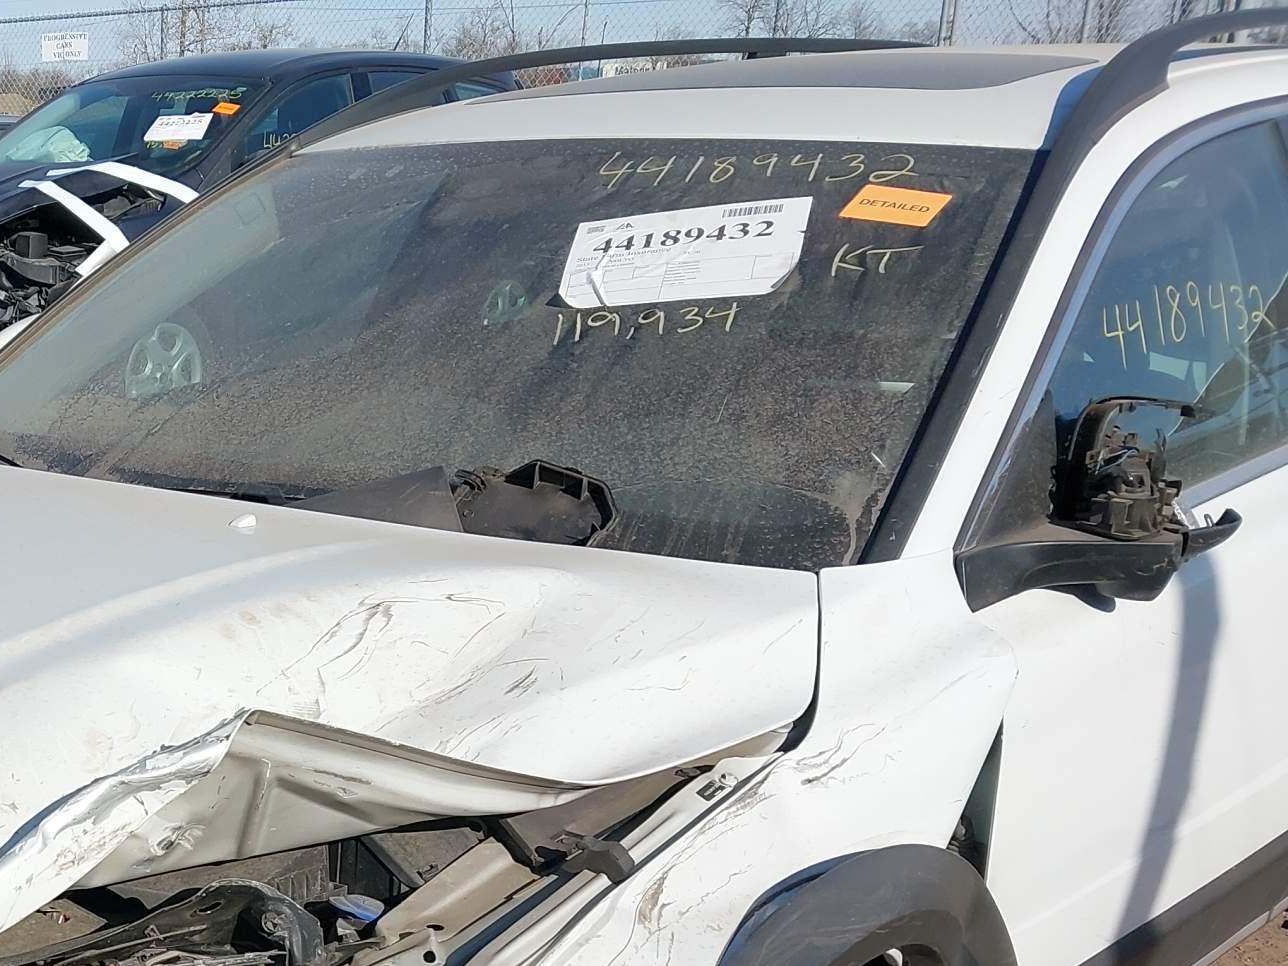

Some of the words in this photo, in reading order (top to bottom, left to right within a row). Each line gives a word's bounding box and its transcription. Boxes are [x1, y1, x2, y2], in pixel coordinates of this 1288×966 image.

[43, 33, 87, 41] PROGRESSIVE
[599, 151, 920, 189] 44189432
[859, 198, 931, 213] DETAILED
[592, 220, 775, 254] 44189432
[831, 243, 925, 277] KT
[553, 301, 742, 346] 119,934
[1103, 281, 1277, 370] 44189432
